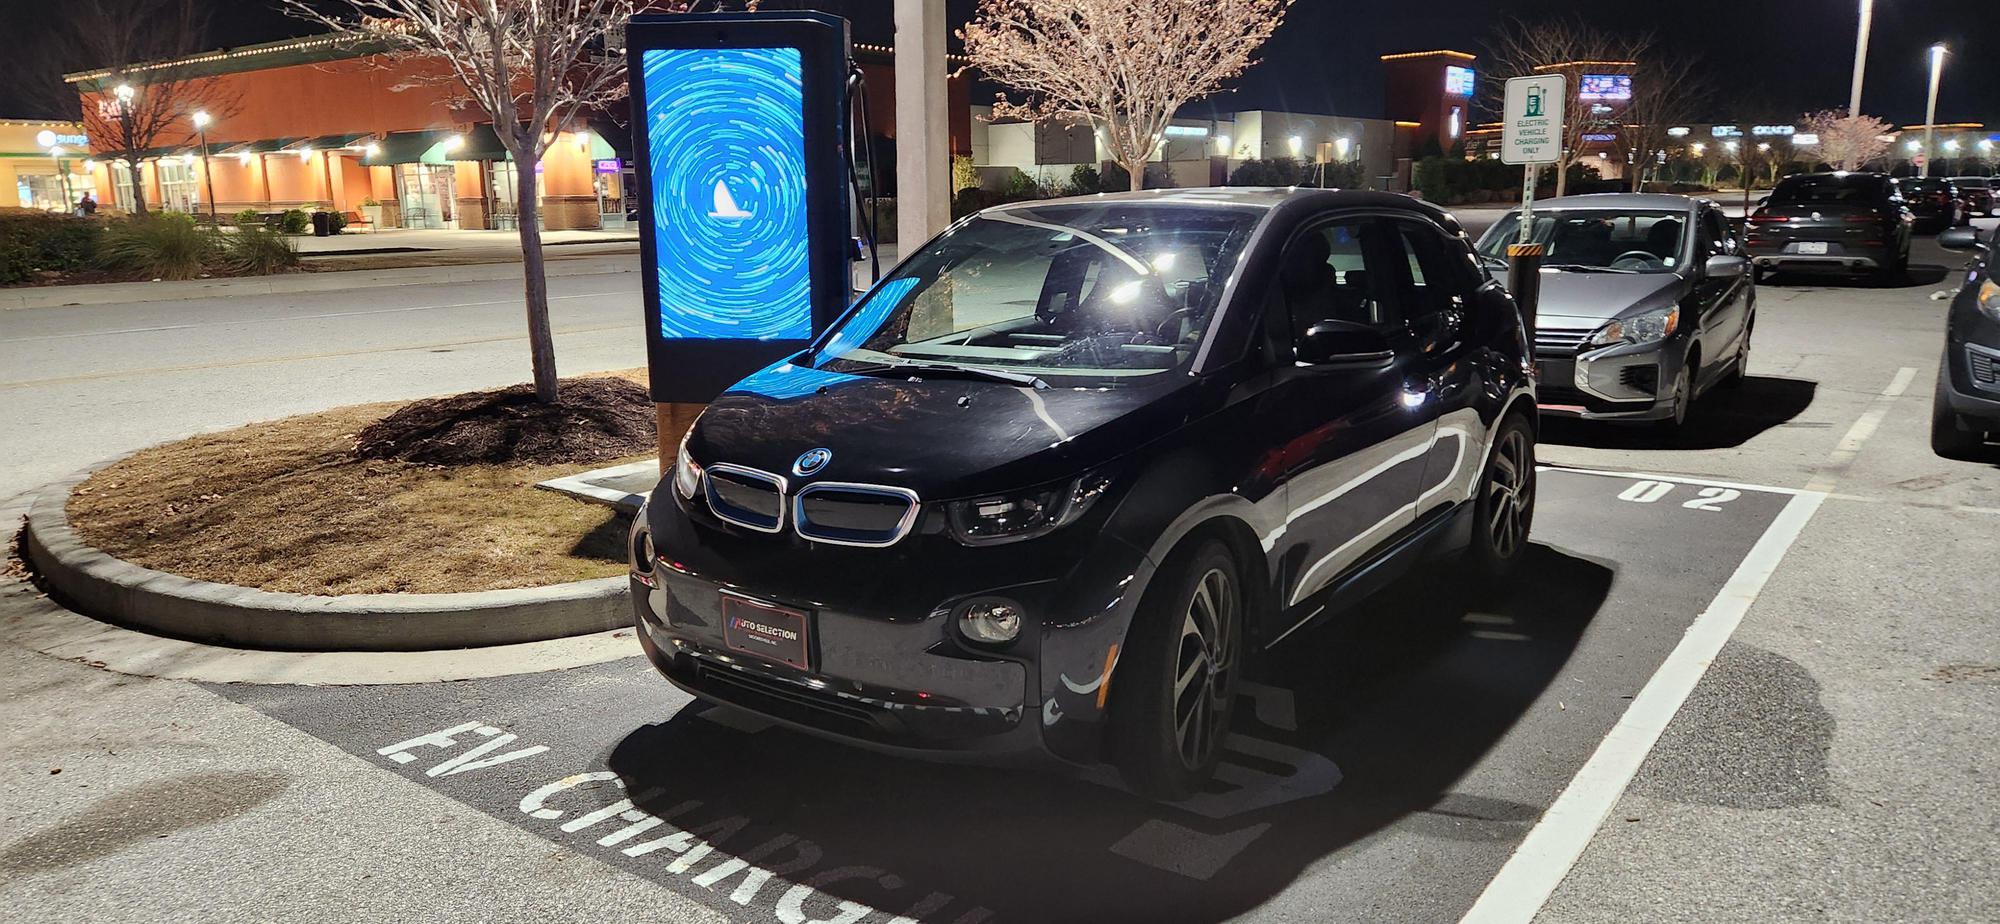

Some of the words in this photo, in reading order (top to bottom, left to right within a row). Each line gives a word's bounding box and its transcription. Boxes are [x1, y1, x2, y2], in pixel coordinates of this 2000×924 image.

[1519, 128, 1547, 136] VEHICLE
[1514, 138, 1550, 146] CHARGING
[756, 623, 797, 640] SELECTION
[376, 721, 550, 777] EV
